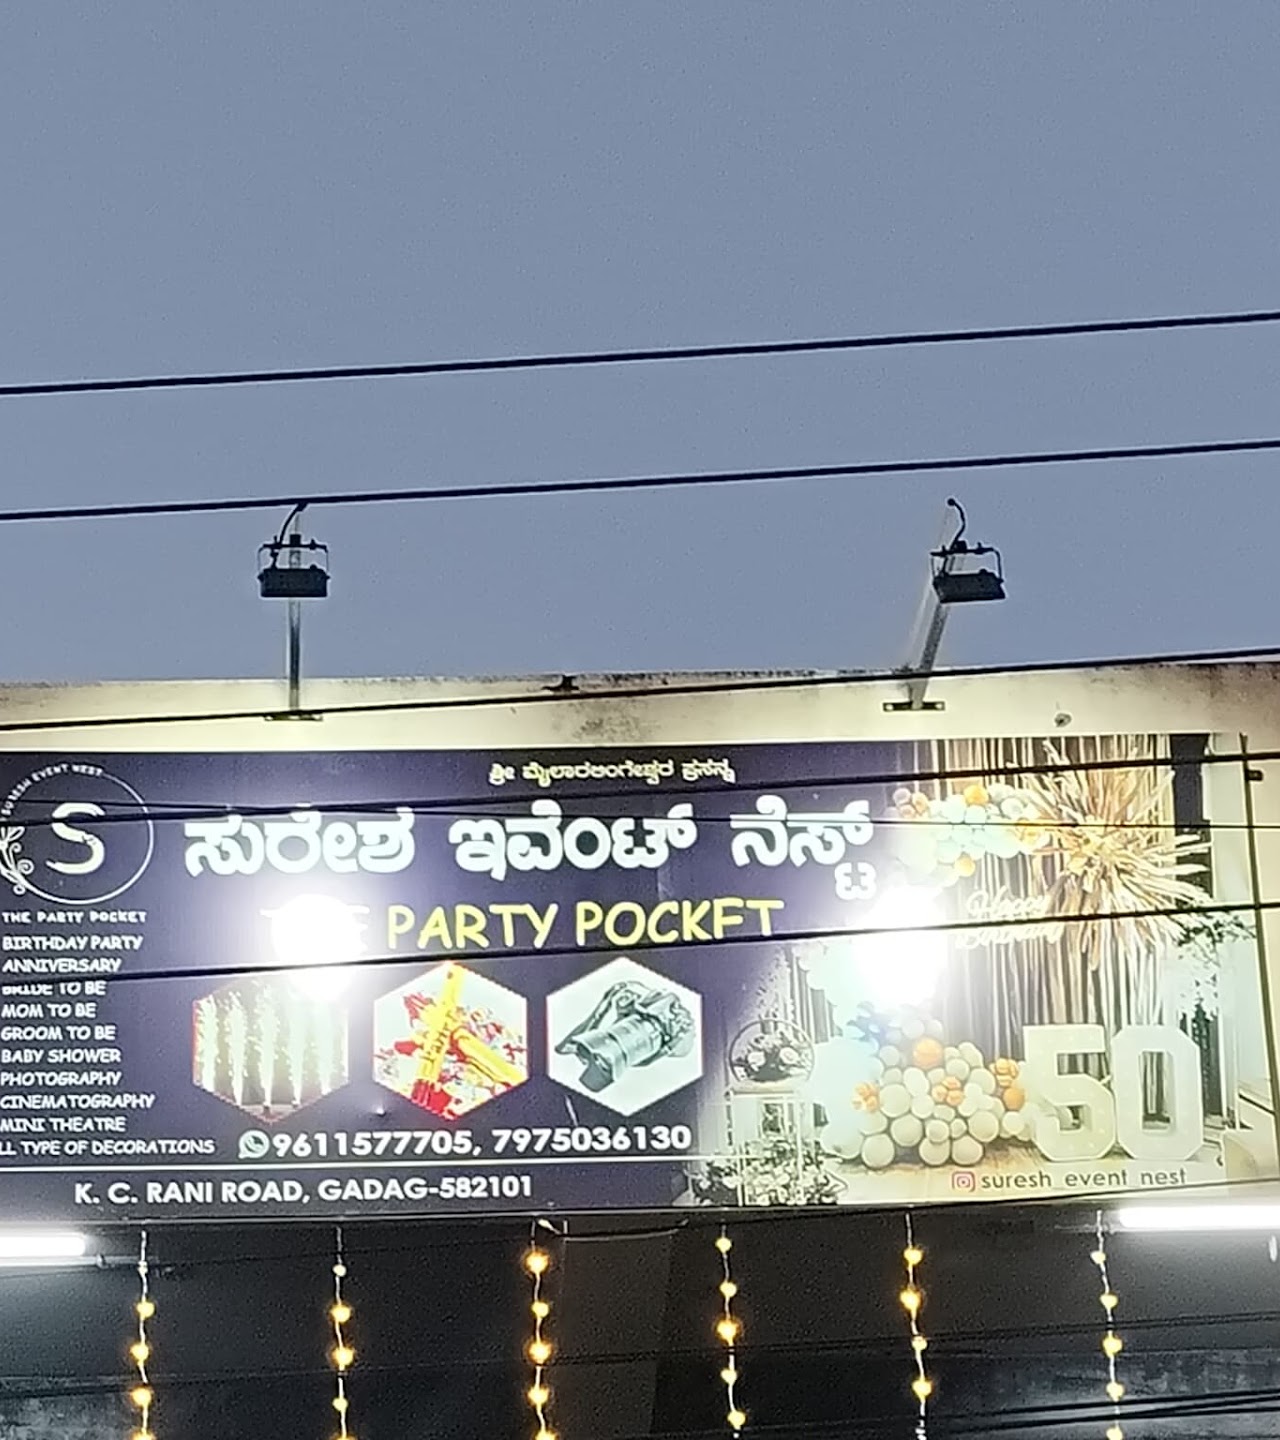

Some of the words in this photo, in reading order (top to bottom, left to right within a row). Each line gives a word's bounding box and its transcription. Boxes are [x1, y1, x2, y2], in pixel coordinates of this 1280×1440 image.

[184, 806, 416, 878] ಸುರೇಶ
[449, 799, 697, 882] ಇವೆಂಟ್
[2, 912, 31, 922] THE
[37, 912, 84, 923] PARTY
[90, 911, 147, 923] POCKET
[388, 905, 558, 949] PARTY
[577, 898, 784, 946] POCKET
[2, 936, 88, 951] BIRTHDAY
[91, 935, 143, 950] PARTY
[2, 958, 122, 973] ANNIVERSARY
[59, 983, 79, 995] TO
[85, 980, 107, 995] BE
[1, 1004, 43, 1018] MOM
[47, 1003, 71, 1018] TO
[75, 1002, 97, 1018] BE
[0, 1026, 63, 1041] GROOM
[66, 1025, 91, 1040] TO
[94, 1025, 117, 1040] BE
[1, 1049, 43, 1063] BABY
[47, 1048, 122, 1063] SHOWER
[0, 1071, 122, 1086] PHOTOGRAPHY
[0, 1093, 155, 1109] CINEMATOGRAPHY
[0, 1117, 46, 1133] MINI
[49, 1116, 126, 1132] THEATRE
[20, 1140, 61, 1155] TYPE
[64, 1140, 89, 1155] OF
[92, 1139, 215, 1154] DECORATIONS
[274, 1131, 481, 1158] 9611577705,
[492, 1125, 692, 1153] 7975036130
[74, 1183, 100, 1205] K.
[107, 1182, 139, 1204] C.
[146, 1181, 214, 1204] RANI
[220, 1180, 311, 1204] ROAD,
[317, 1176, 532, 1202] GADAG-582101
